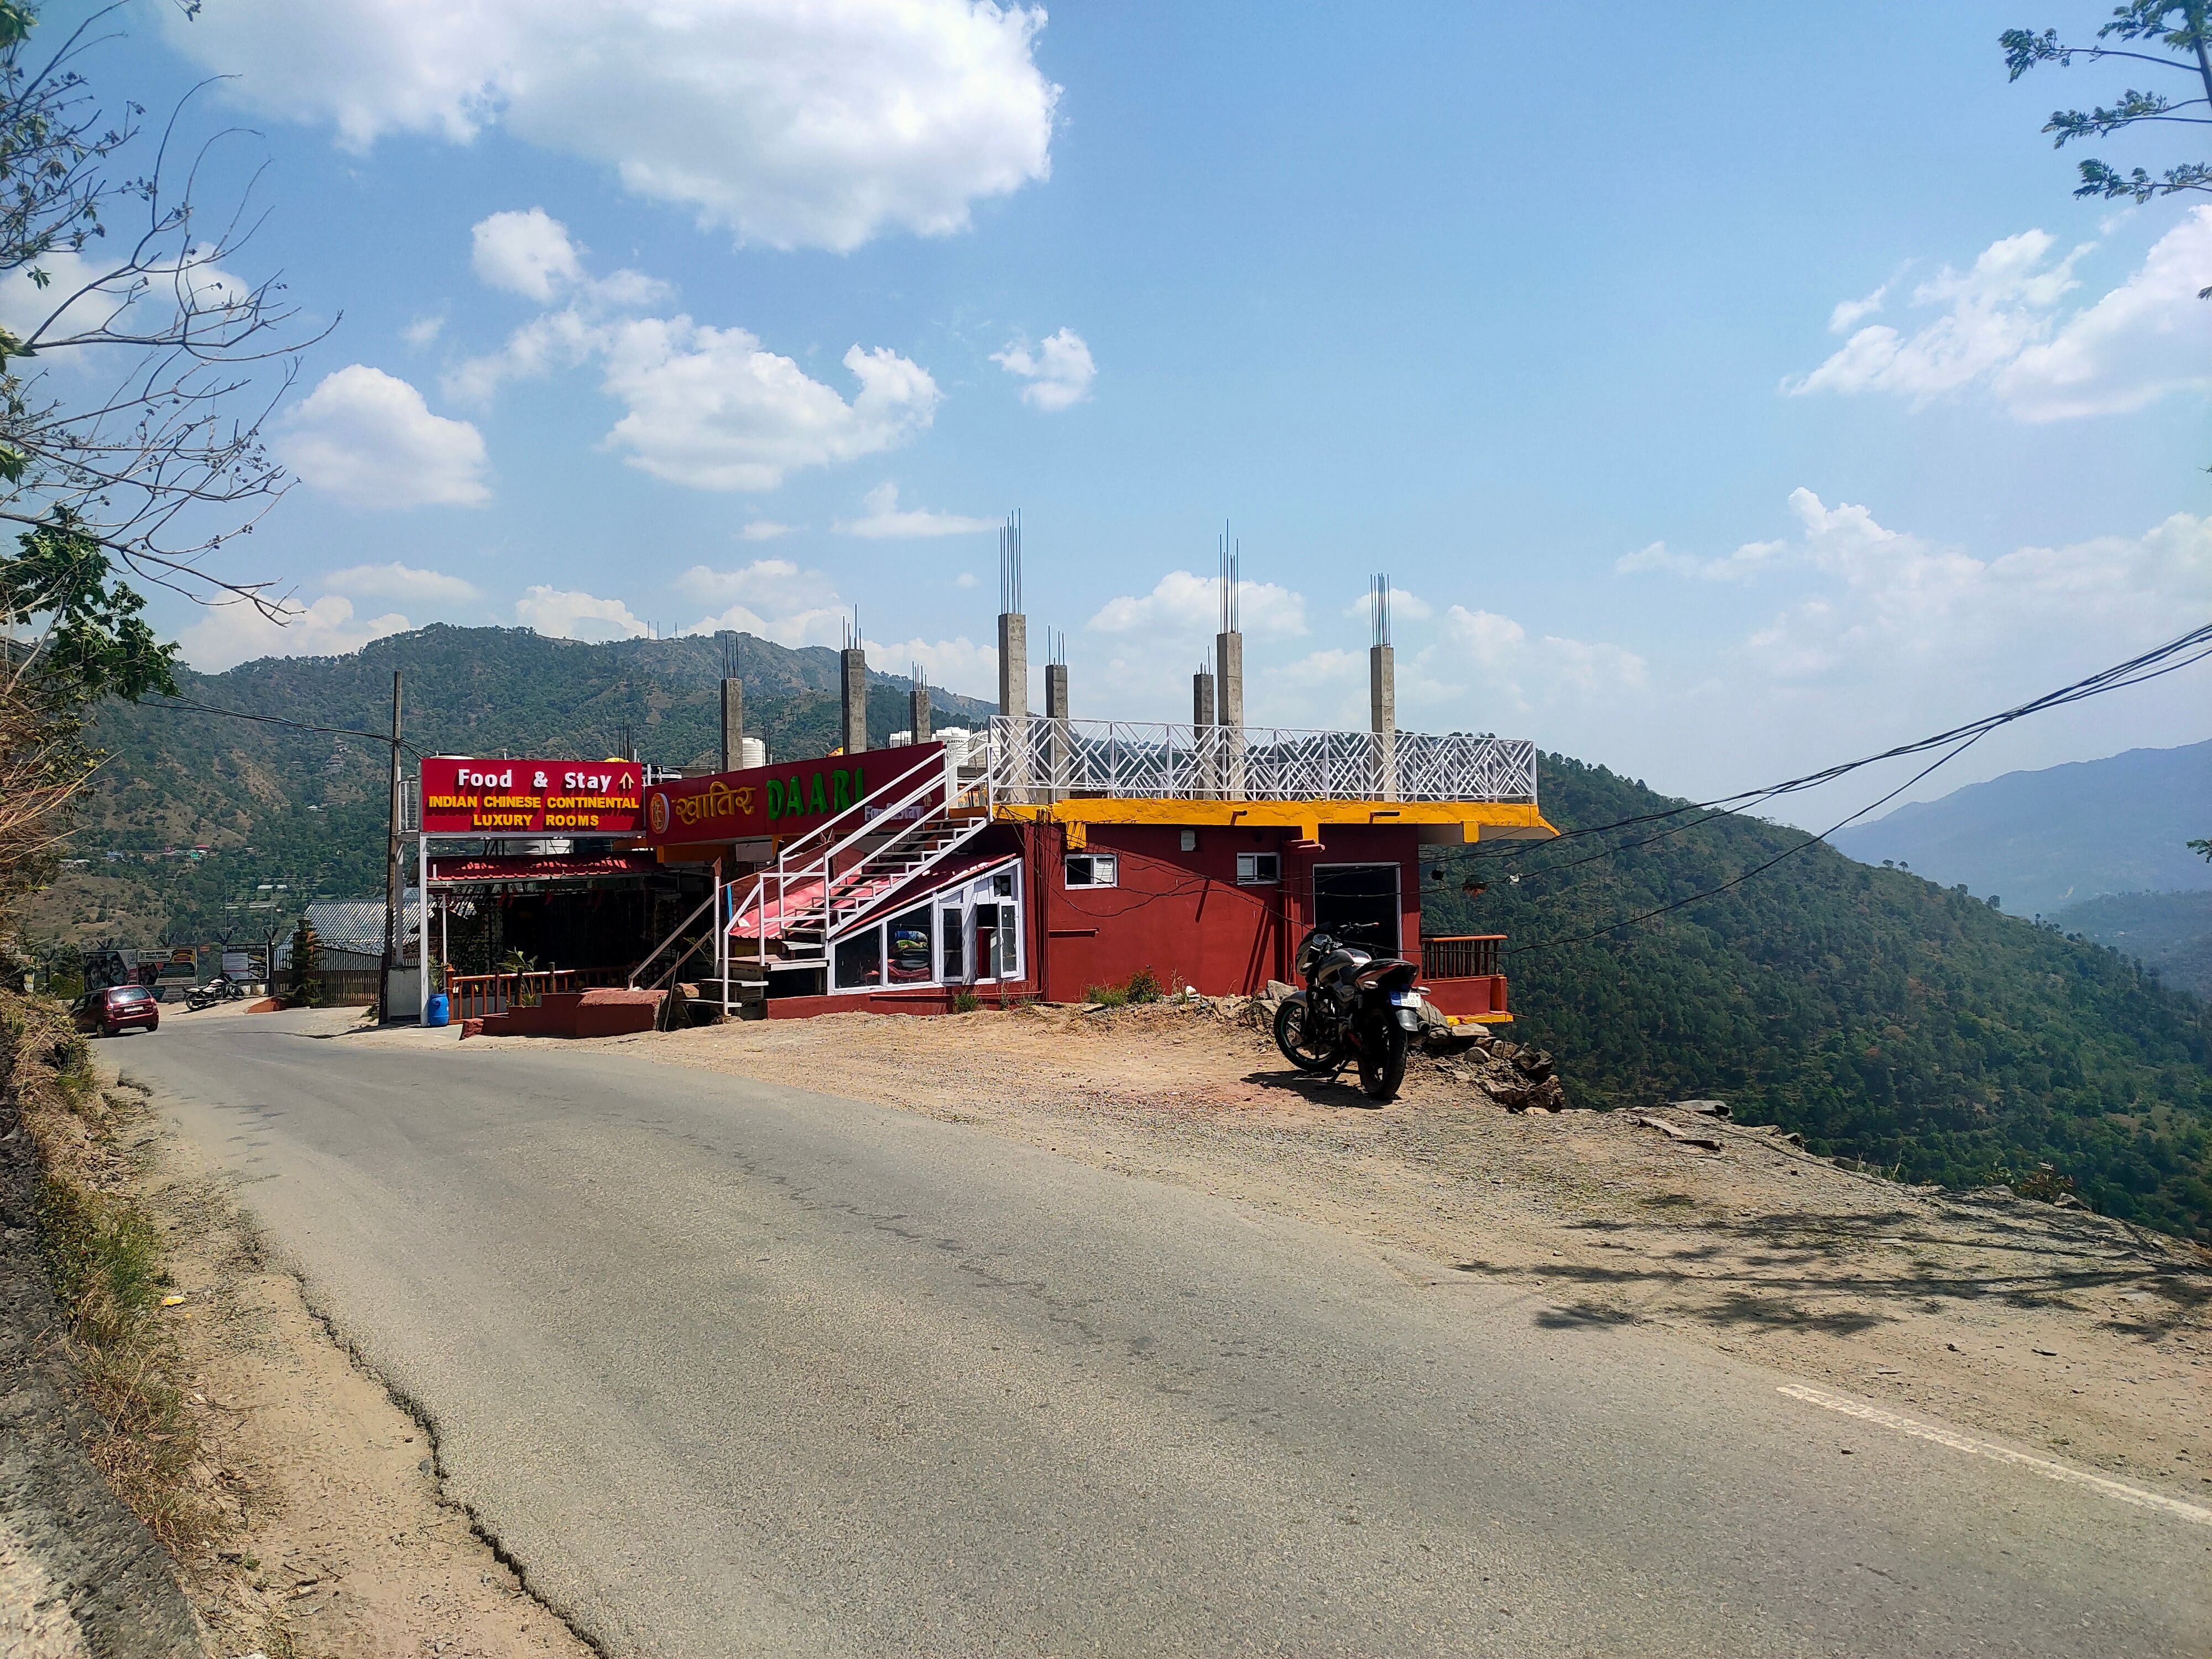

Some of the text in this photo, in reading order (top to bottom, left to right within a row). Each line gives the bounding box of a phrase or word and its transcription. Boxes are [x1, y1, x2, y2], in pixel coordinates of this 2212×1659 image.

[458, 769, 612, 792] Food & Stay
[429, 795, 639, 808] INDIAN CHINESE CONTINENTAL
[671, 781, 757, 825] खातिर
[766, 767, 864, 820] DAARI
[474, 814, 599, 826] LUXURY ROOMS
